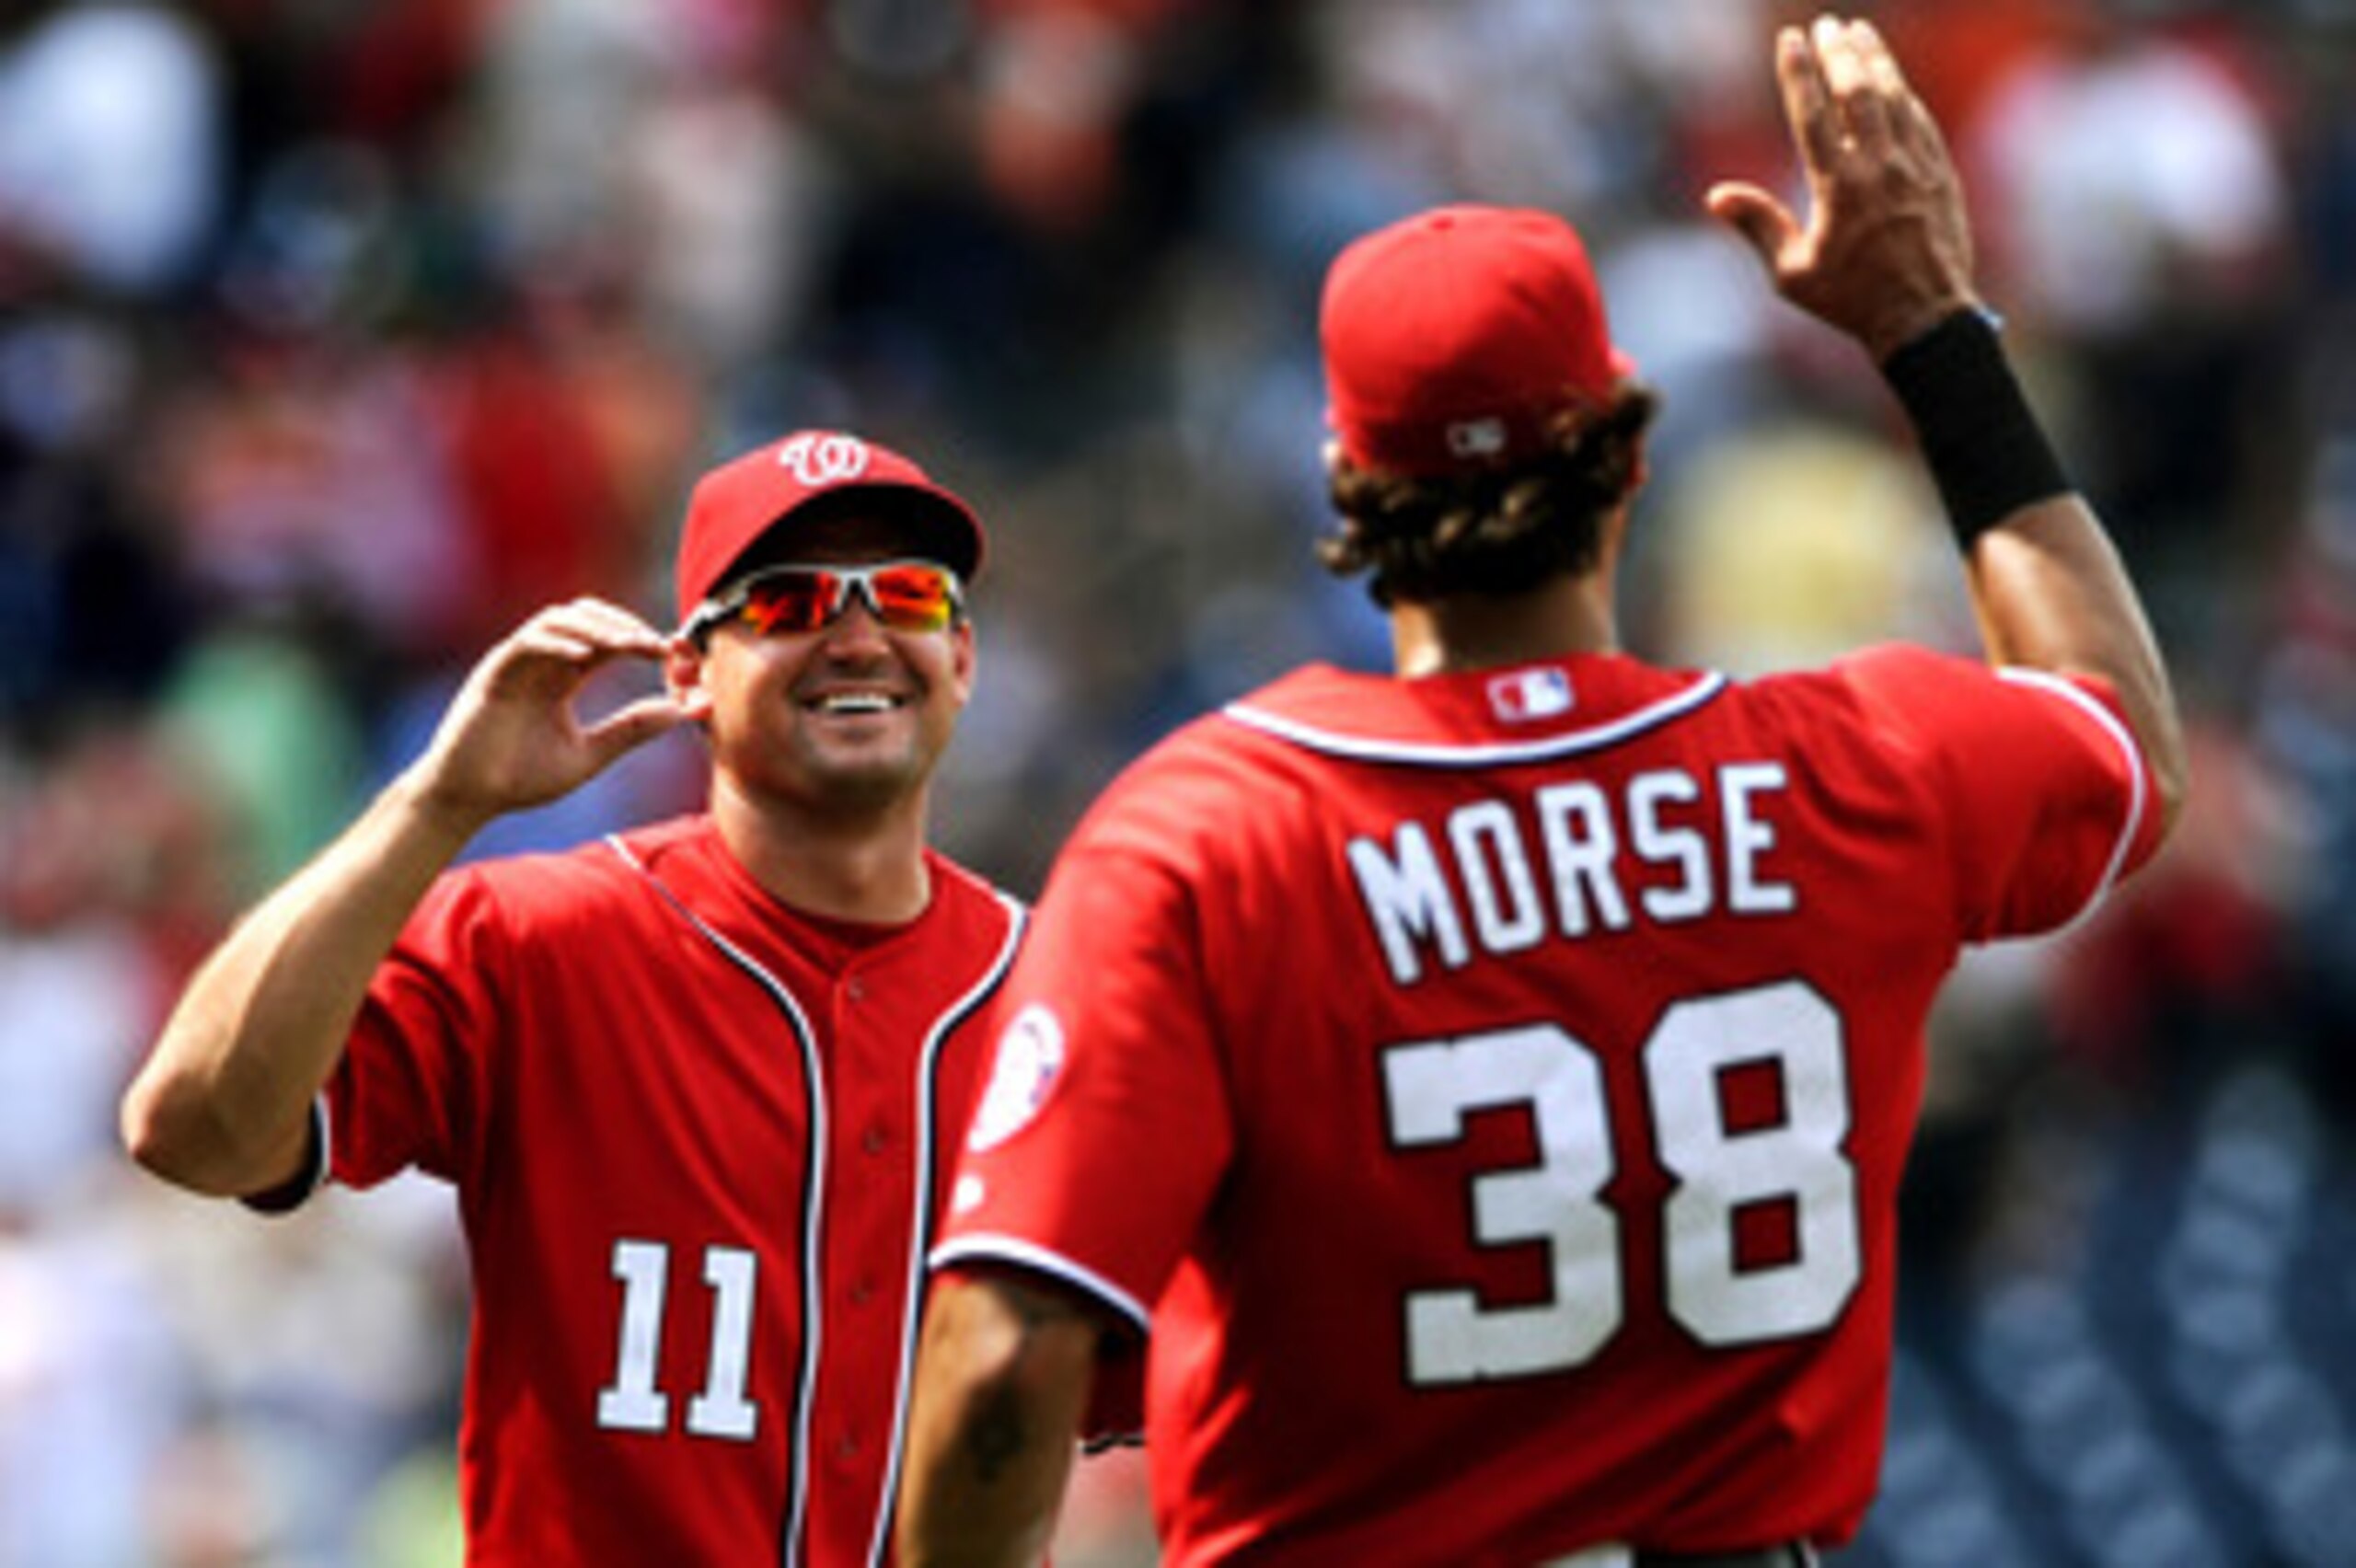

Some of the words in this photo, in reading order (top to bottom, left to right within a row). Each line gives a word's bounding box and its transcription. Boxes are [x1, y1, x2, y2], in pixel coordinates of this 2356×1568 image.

[1345, 761, 1796, 986] MORSE
[1381, 977, 1863, 1388] 38
[596, 1239, 758, 1441] 11
